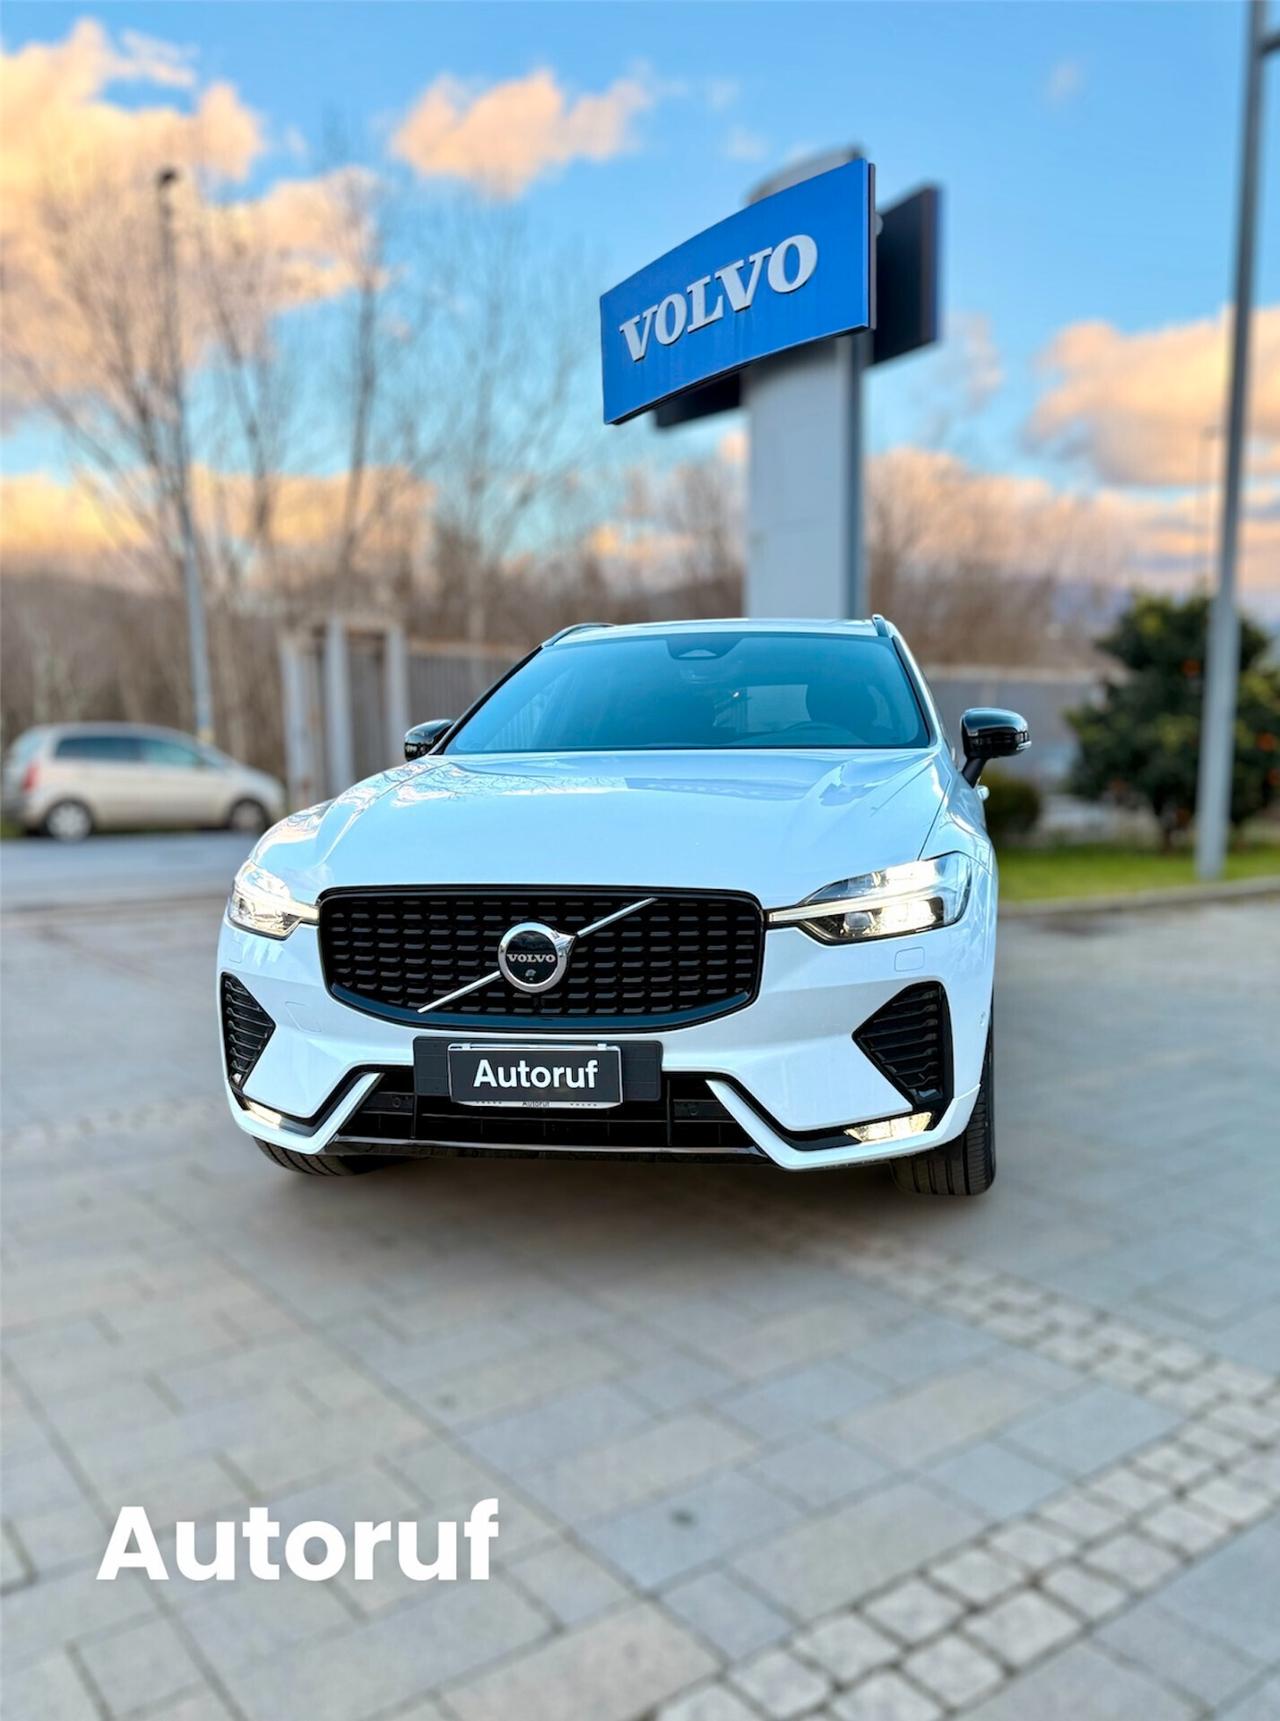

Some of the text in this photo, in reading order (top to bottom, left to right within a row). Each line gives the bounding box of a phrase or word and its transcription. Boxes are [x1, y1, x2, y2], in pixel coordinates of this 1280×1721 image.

[619, 234, 818, 362] VOLVO
[507, 953, 556, 963] VOLVO
[473, 1059, 598, 1088] Autoruf
